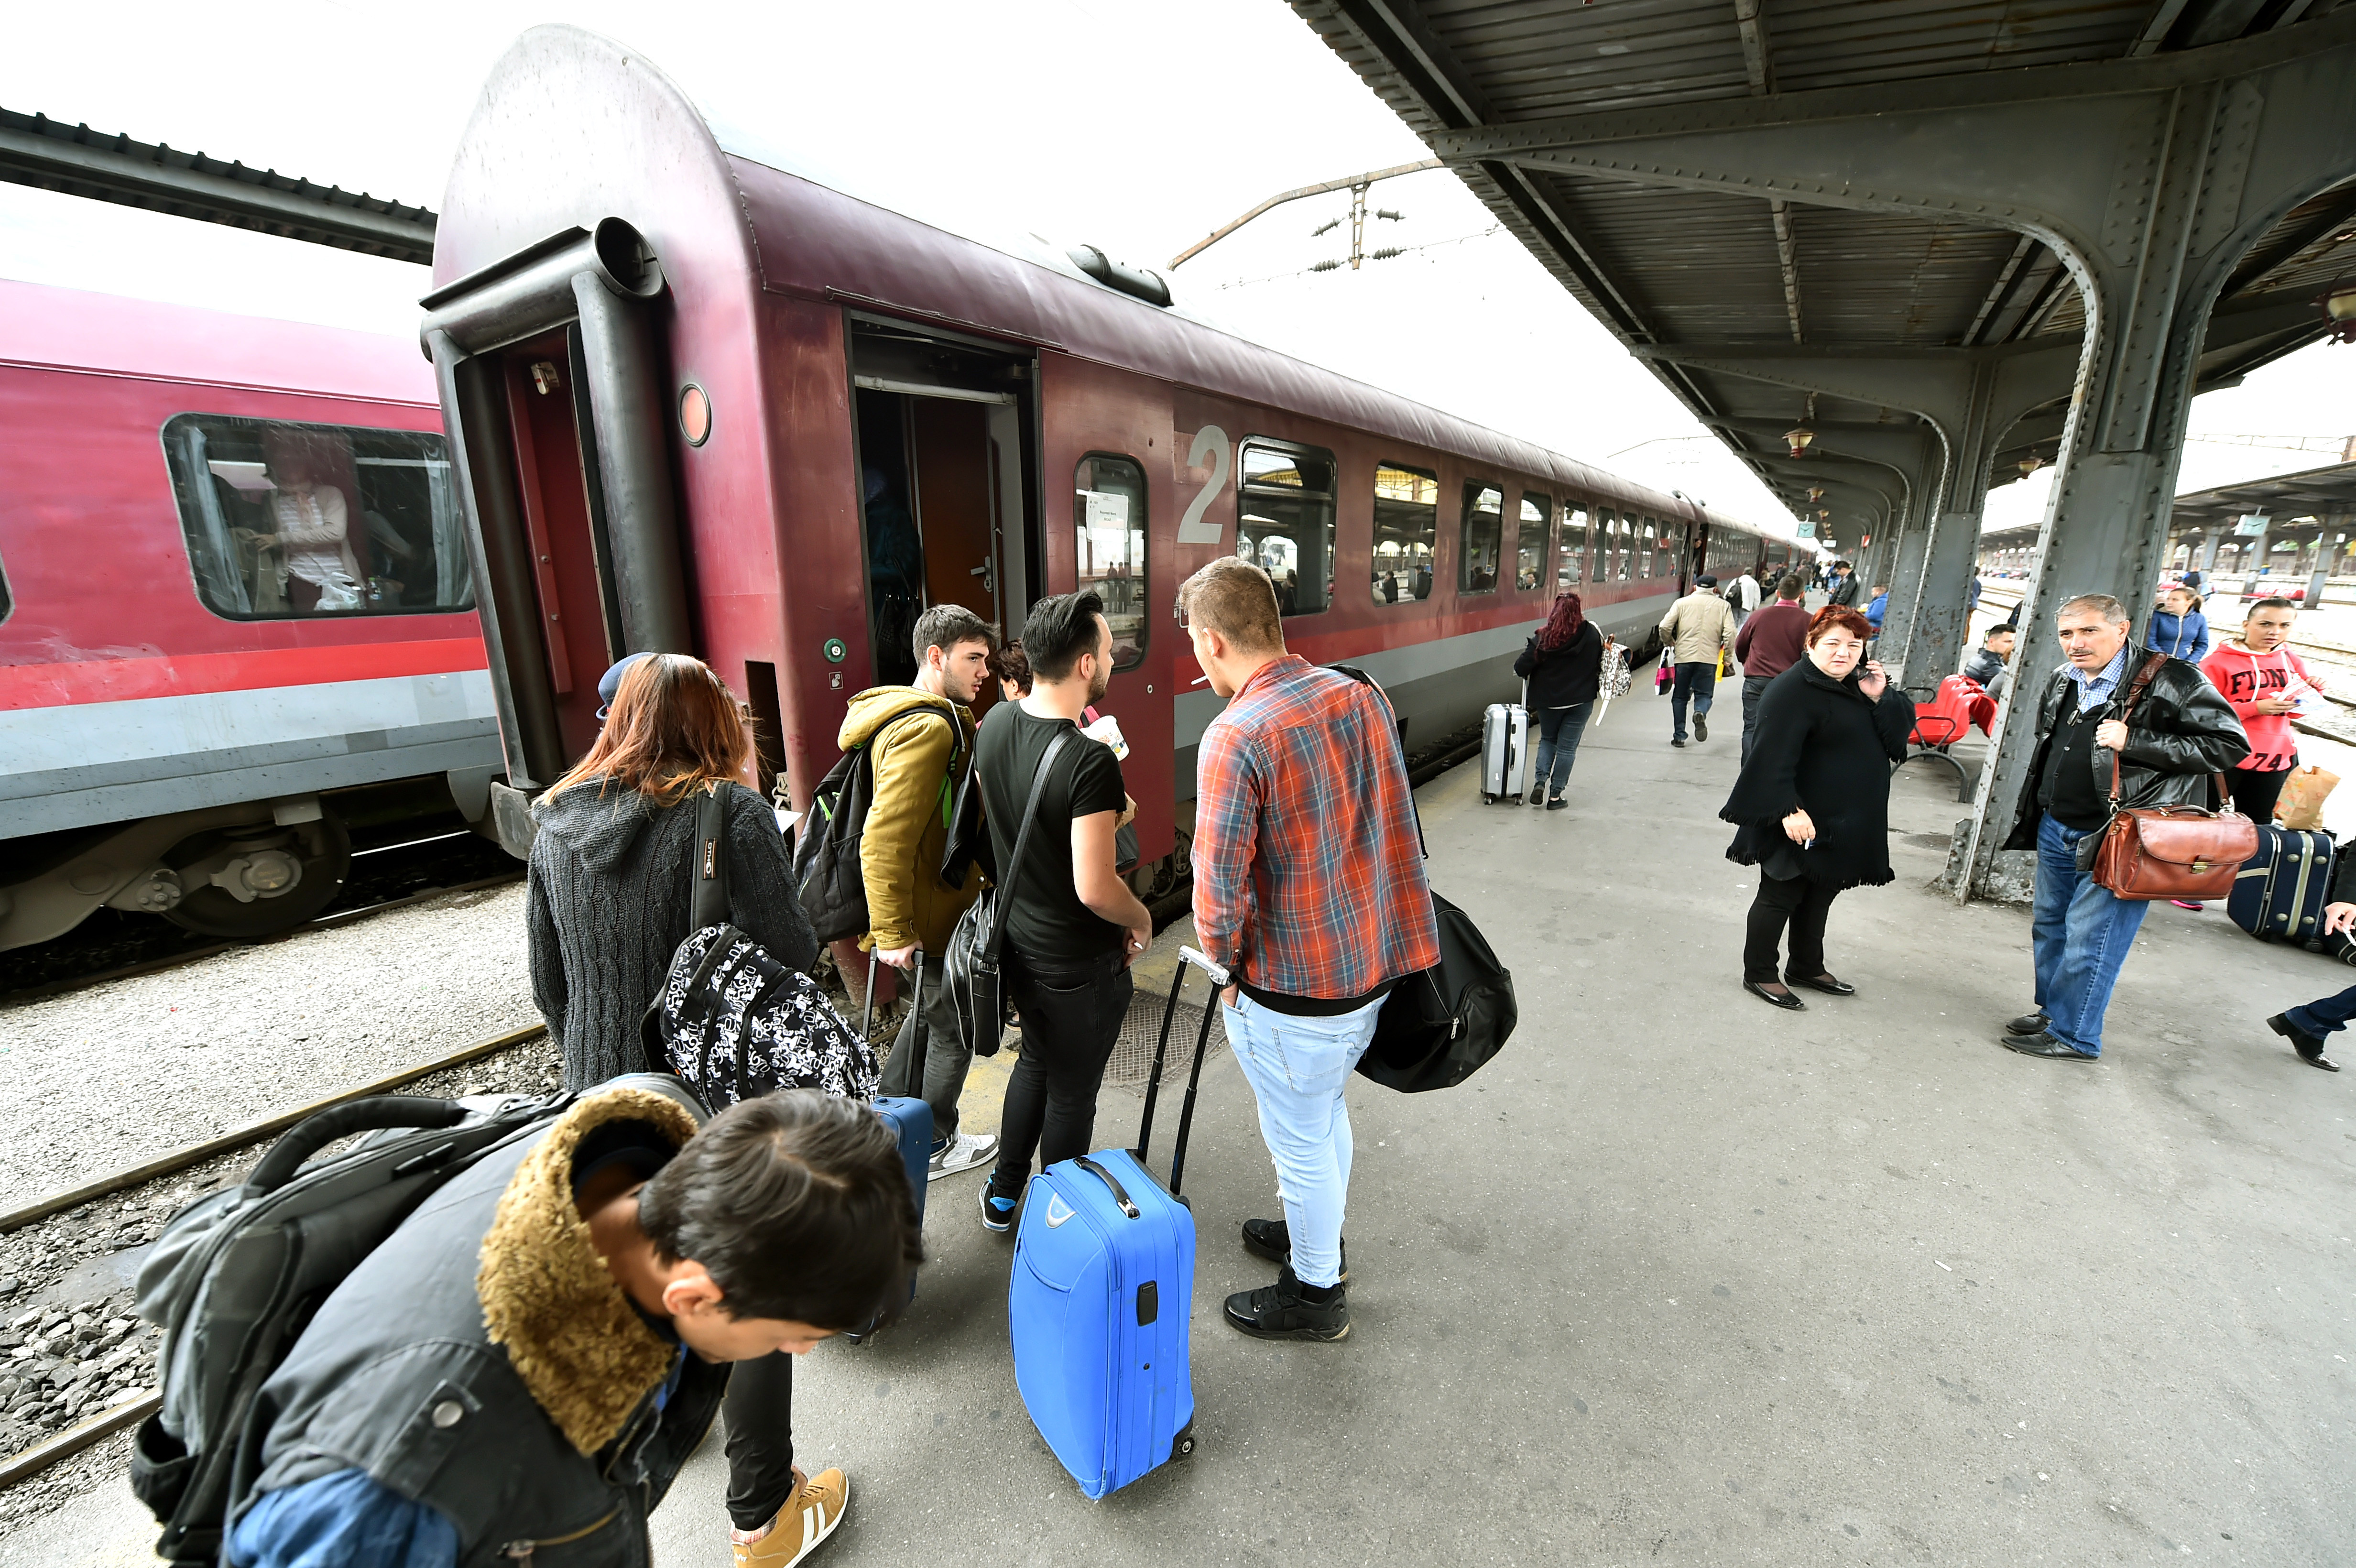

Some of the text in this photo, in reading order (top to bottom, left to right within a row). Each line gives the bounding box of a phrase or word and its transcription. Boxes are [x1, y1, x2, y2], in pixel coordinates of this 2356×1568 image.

[1178, 425, 1230, 544] 2
[2231, 669, 2287, 695] FION
[2254, 752, 2282, 772] 74
